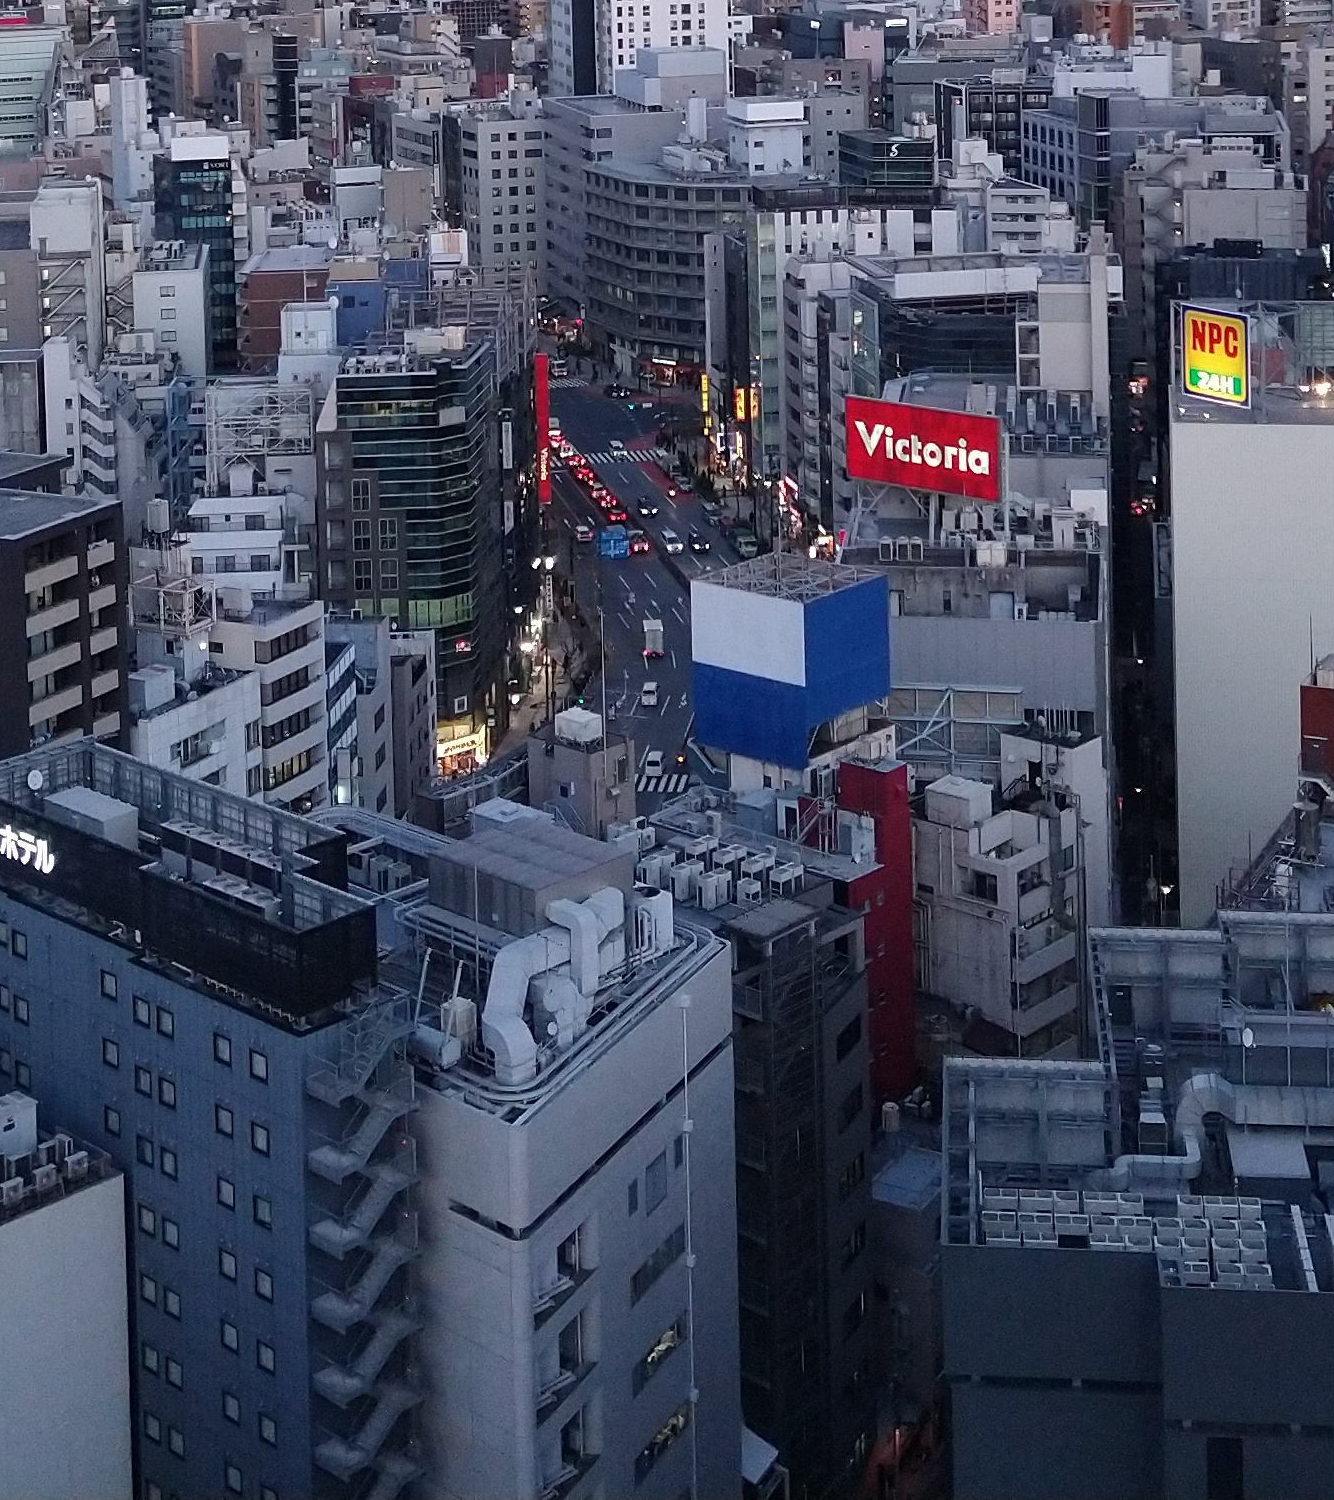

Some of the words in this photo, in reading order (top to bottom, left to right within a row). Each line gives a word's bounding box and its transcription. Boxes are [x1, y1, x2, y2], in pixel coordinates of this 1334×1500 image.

[1191, 318, 1238, 358] NPC
[1197, 371, 1234, 395] 24H
[854, 420, 990, 475] Victoria
